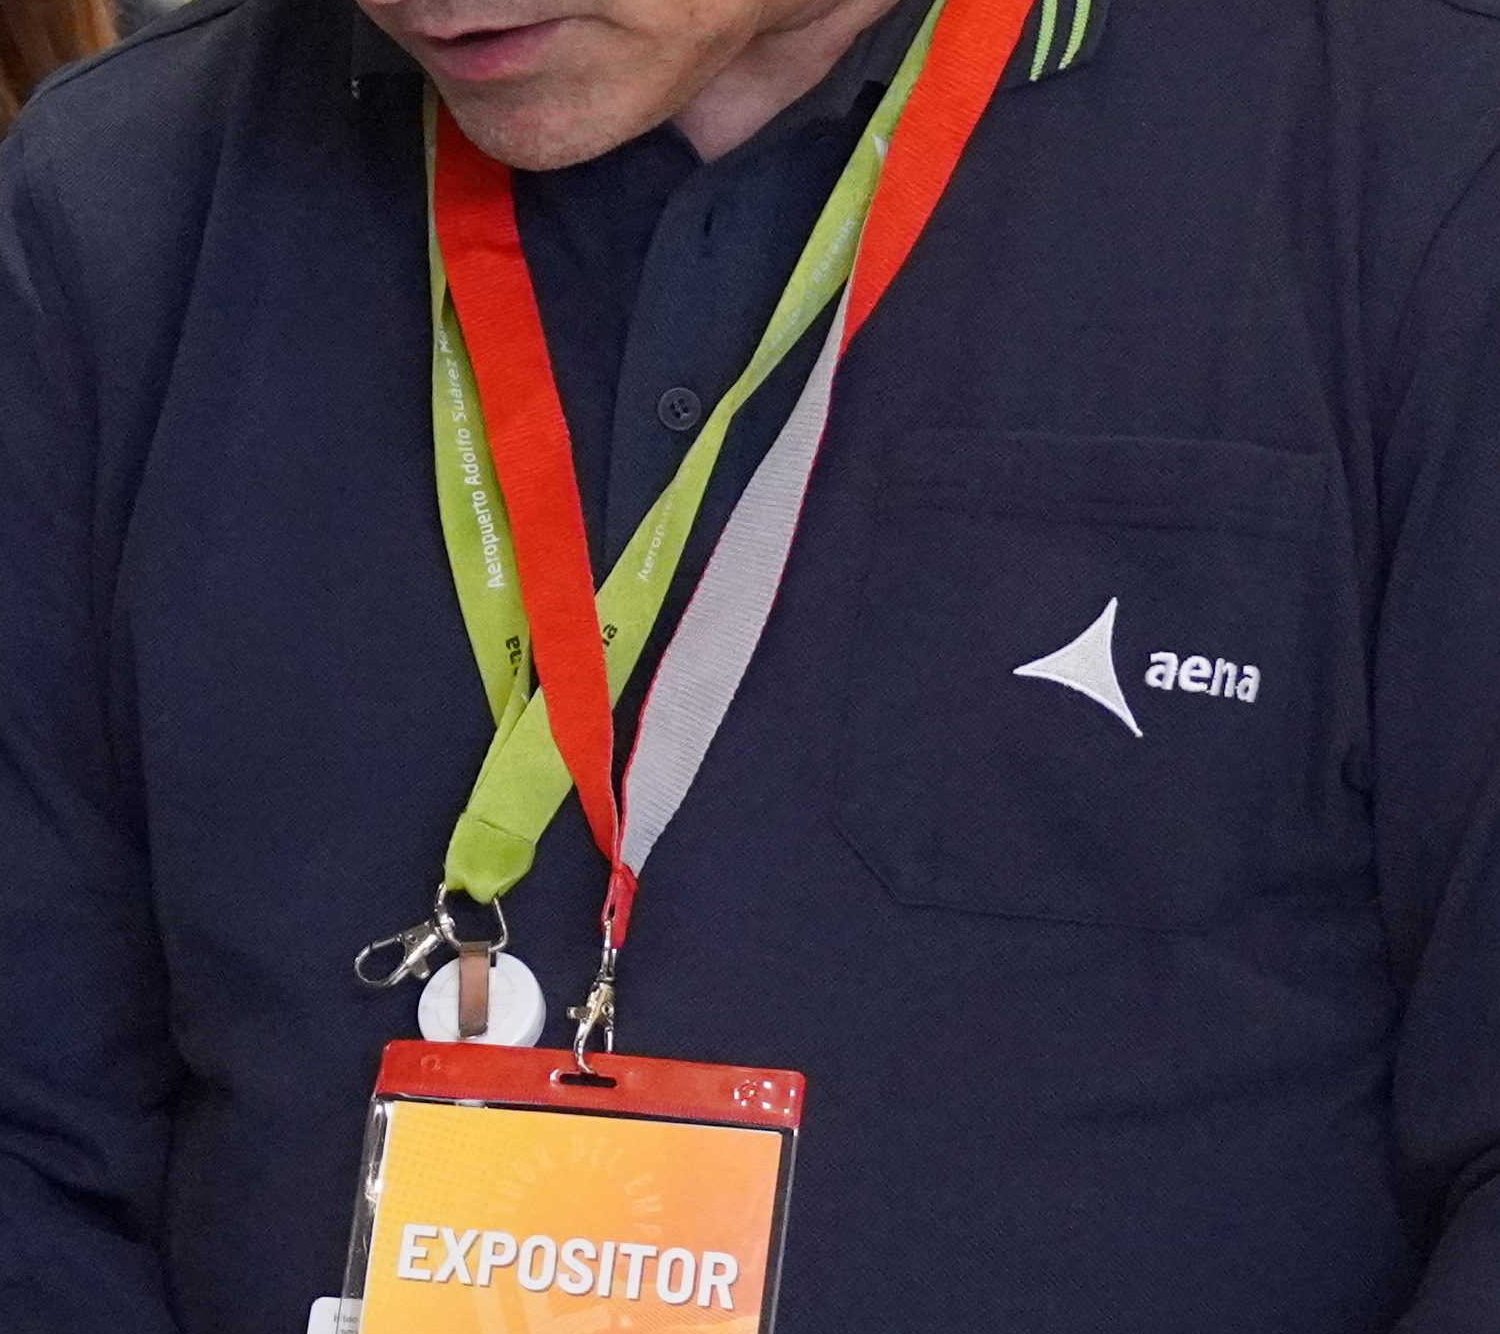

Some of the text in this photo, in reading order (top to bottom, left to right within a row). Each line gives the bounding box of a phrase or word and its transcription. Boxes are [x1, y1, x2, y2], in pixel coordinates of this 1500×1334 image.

[456, 427, 491, 487] Adolfo
[471, 489, 505, 590] Aeropuerto
[1145, 651, 1261, 703] aena
[396, 1223, 740, 1312] EXPOSITOR
